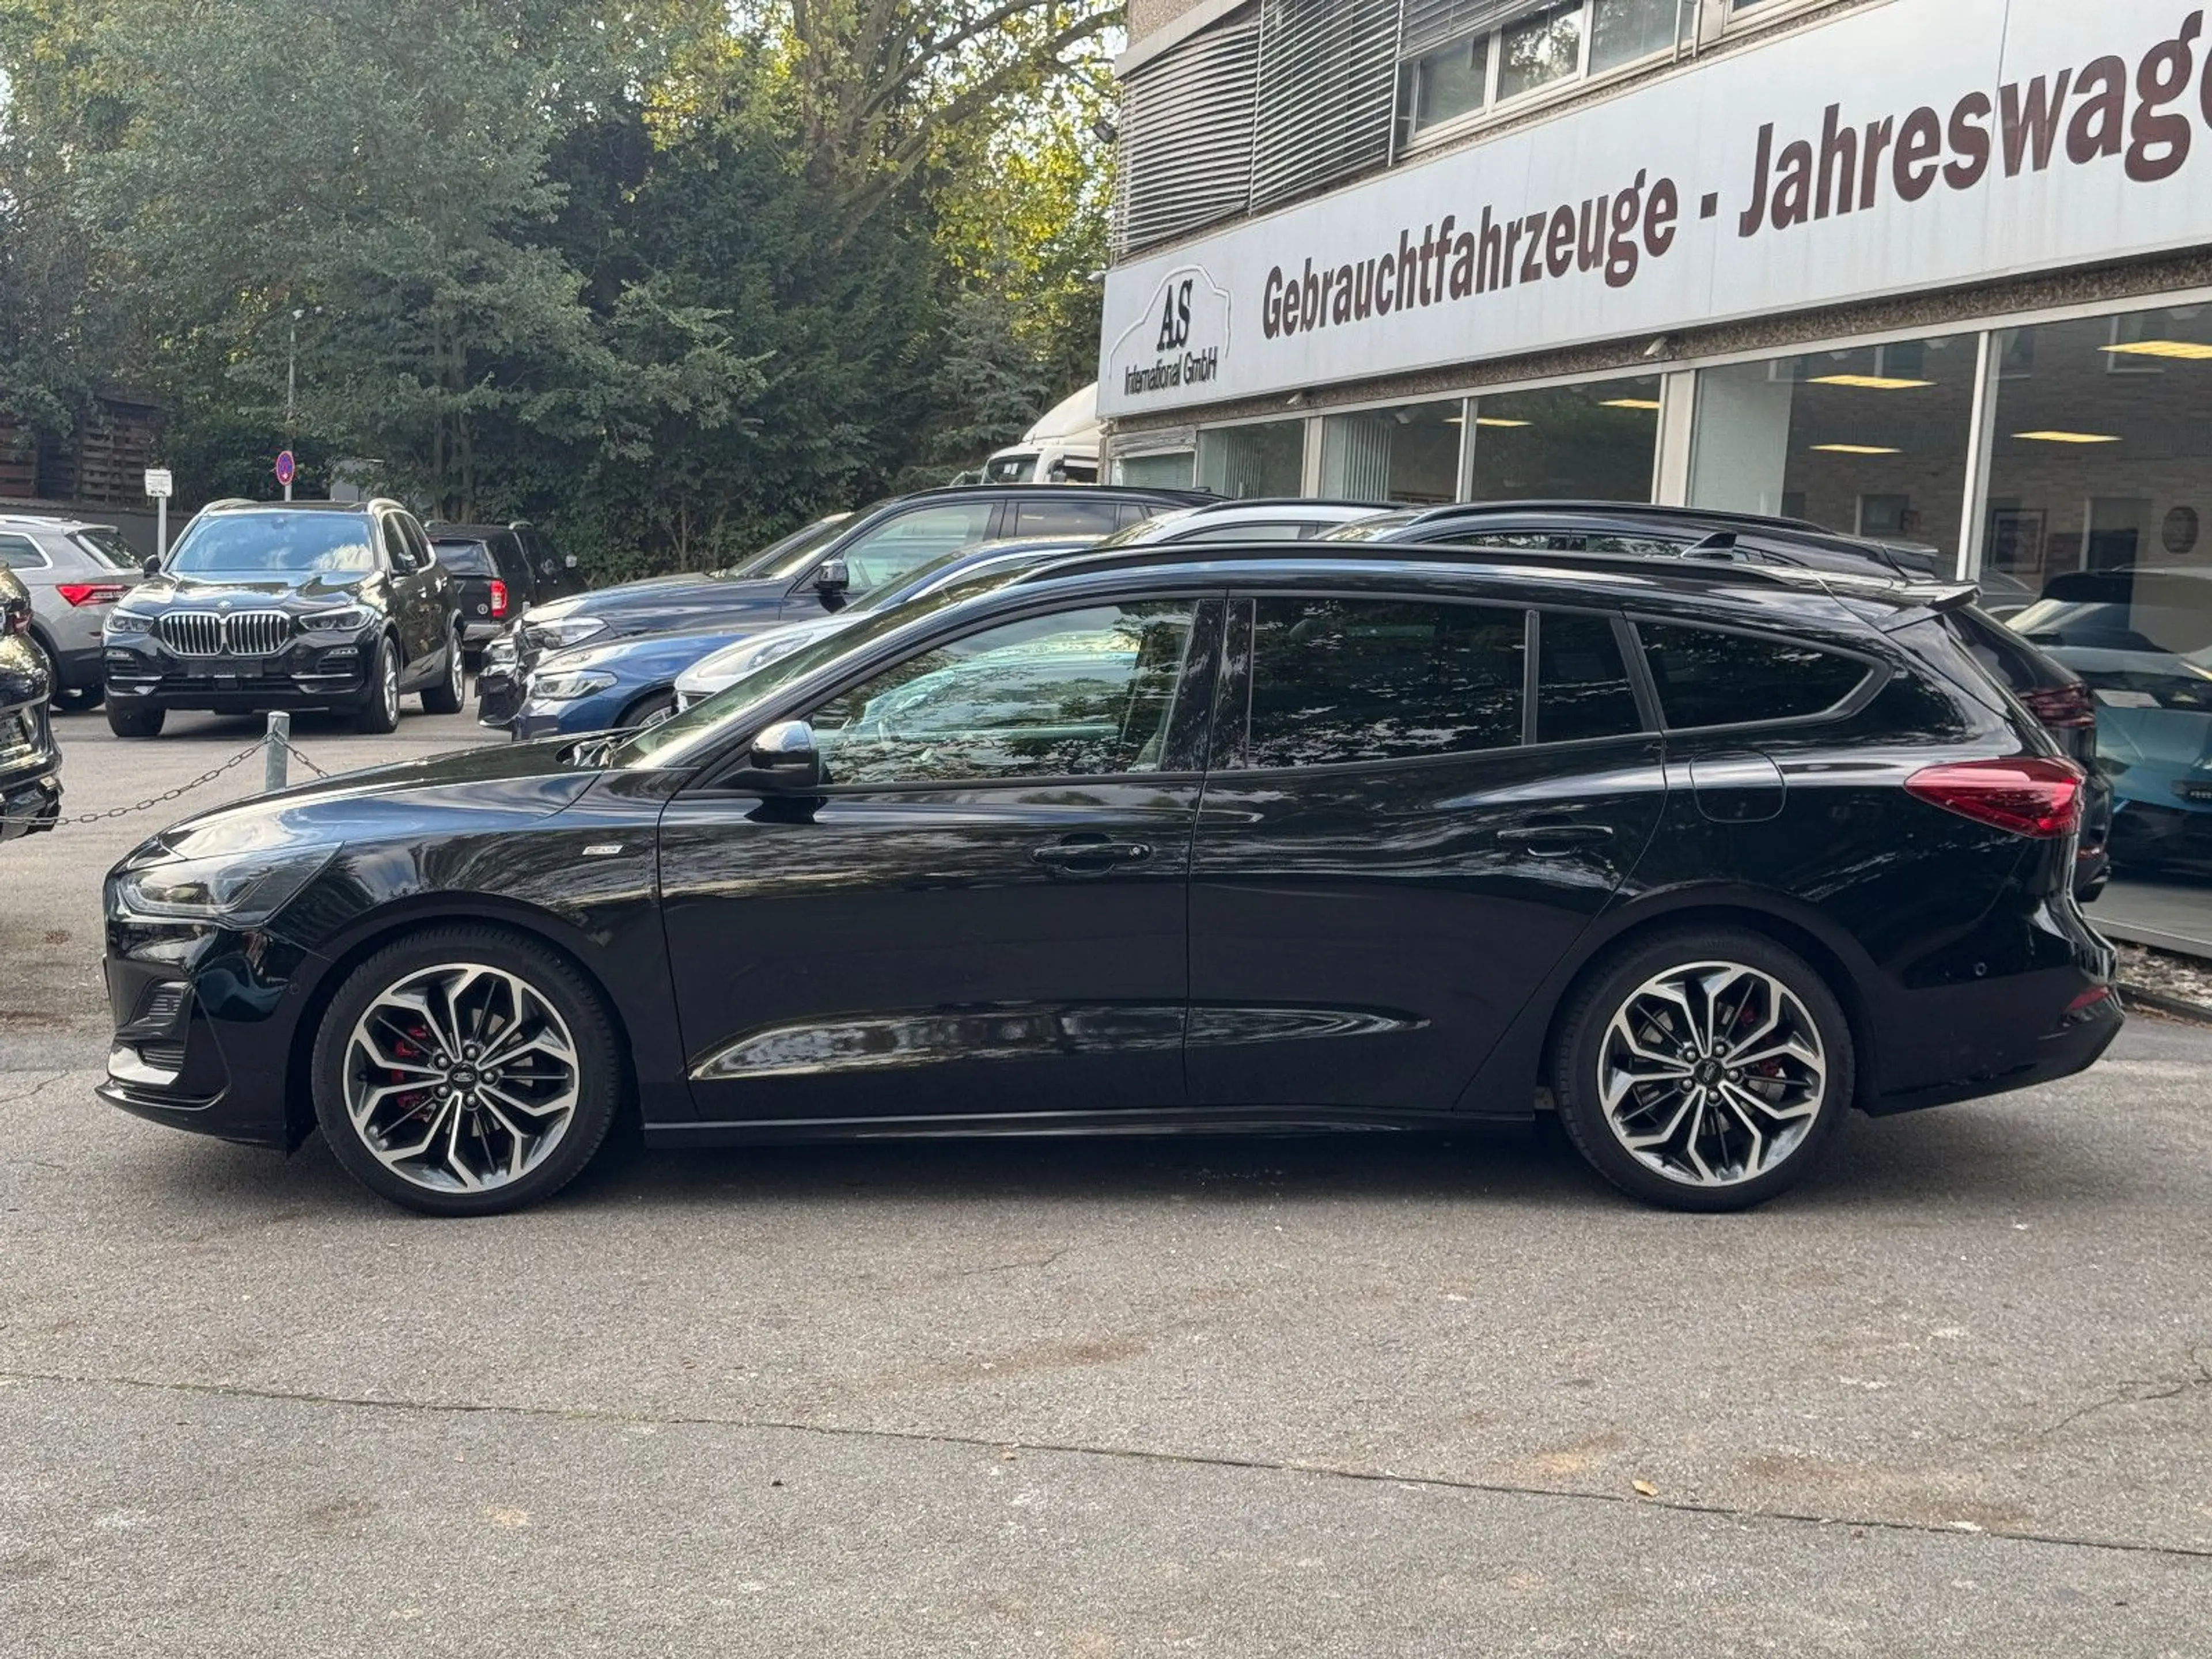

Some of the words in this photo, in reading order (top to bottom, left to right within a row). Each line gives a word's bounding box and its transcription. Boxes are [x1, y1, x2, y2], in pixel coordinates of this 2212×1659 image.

[1263, 168, 1678, 340] Gebrauchtfahrzeuge
[1738, 9, 2212, 237] Jahreswag
[1124, 353, 1182, 396] International
[1183, 346, 1218, 385] GmbH
